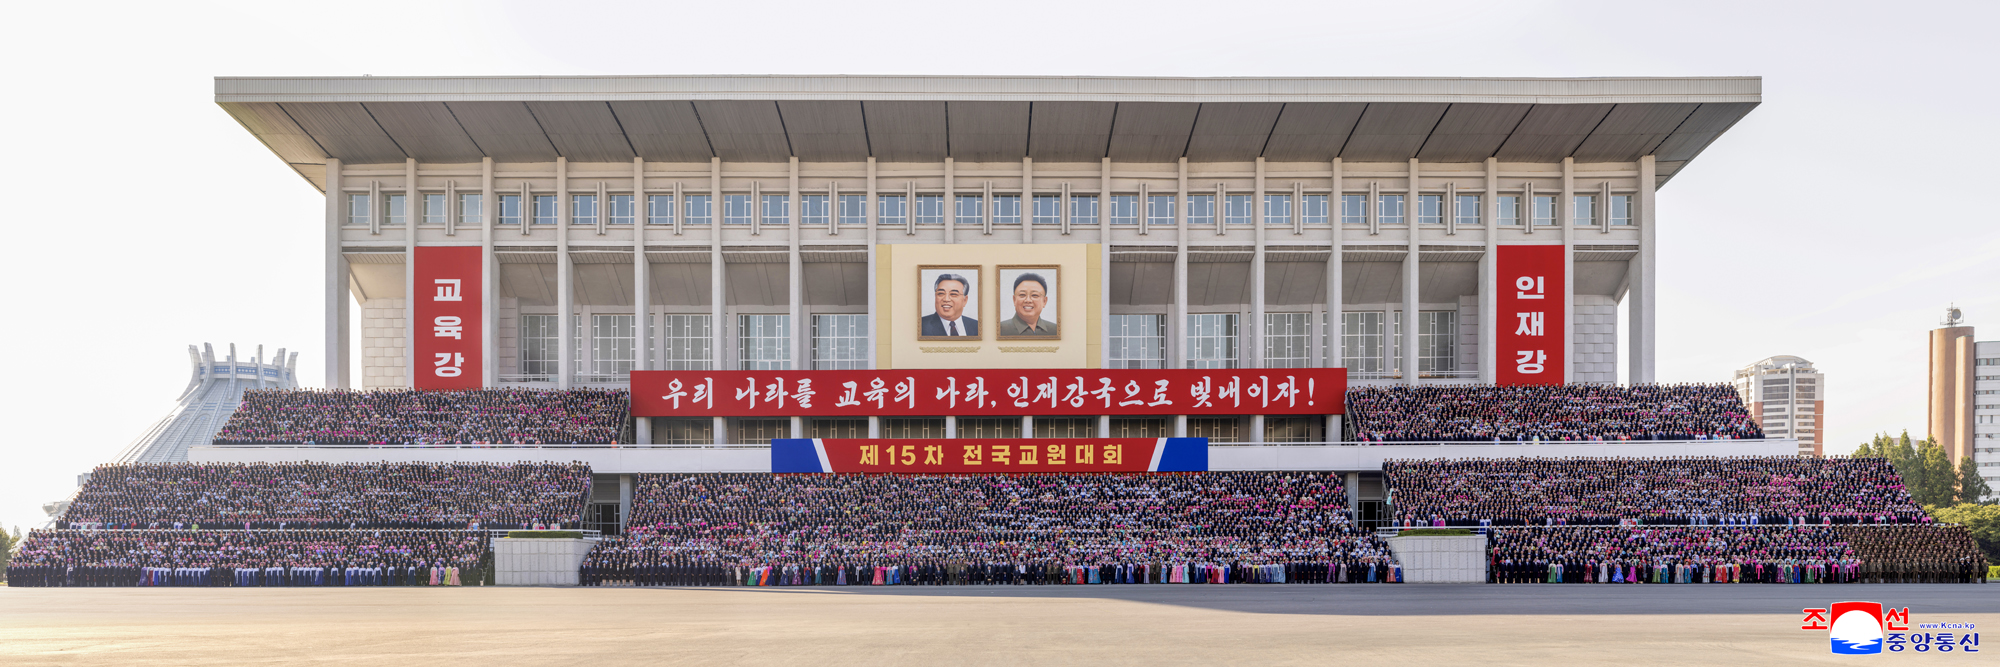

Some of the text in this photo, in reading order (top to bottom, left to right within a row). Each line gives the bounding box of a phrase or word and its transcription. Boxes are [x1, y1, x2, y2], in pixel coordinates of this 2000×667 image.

[661, 375, 1316, 410] 우리 나라를 교육의 나라, 인재강국으로 빛내이자!
[859, 444, 1123, 466] 제15차 전국교원대회
